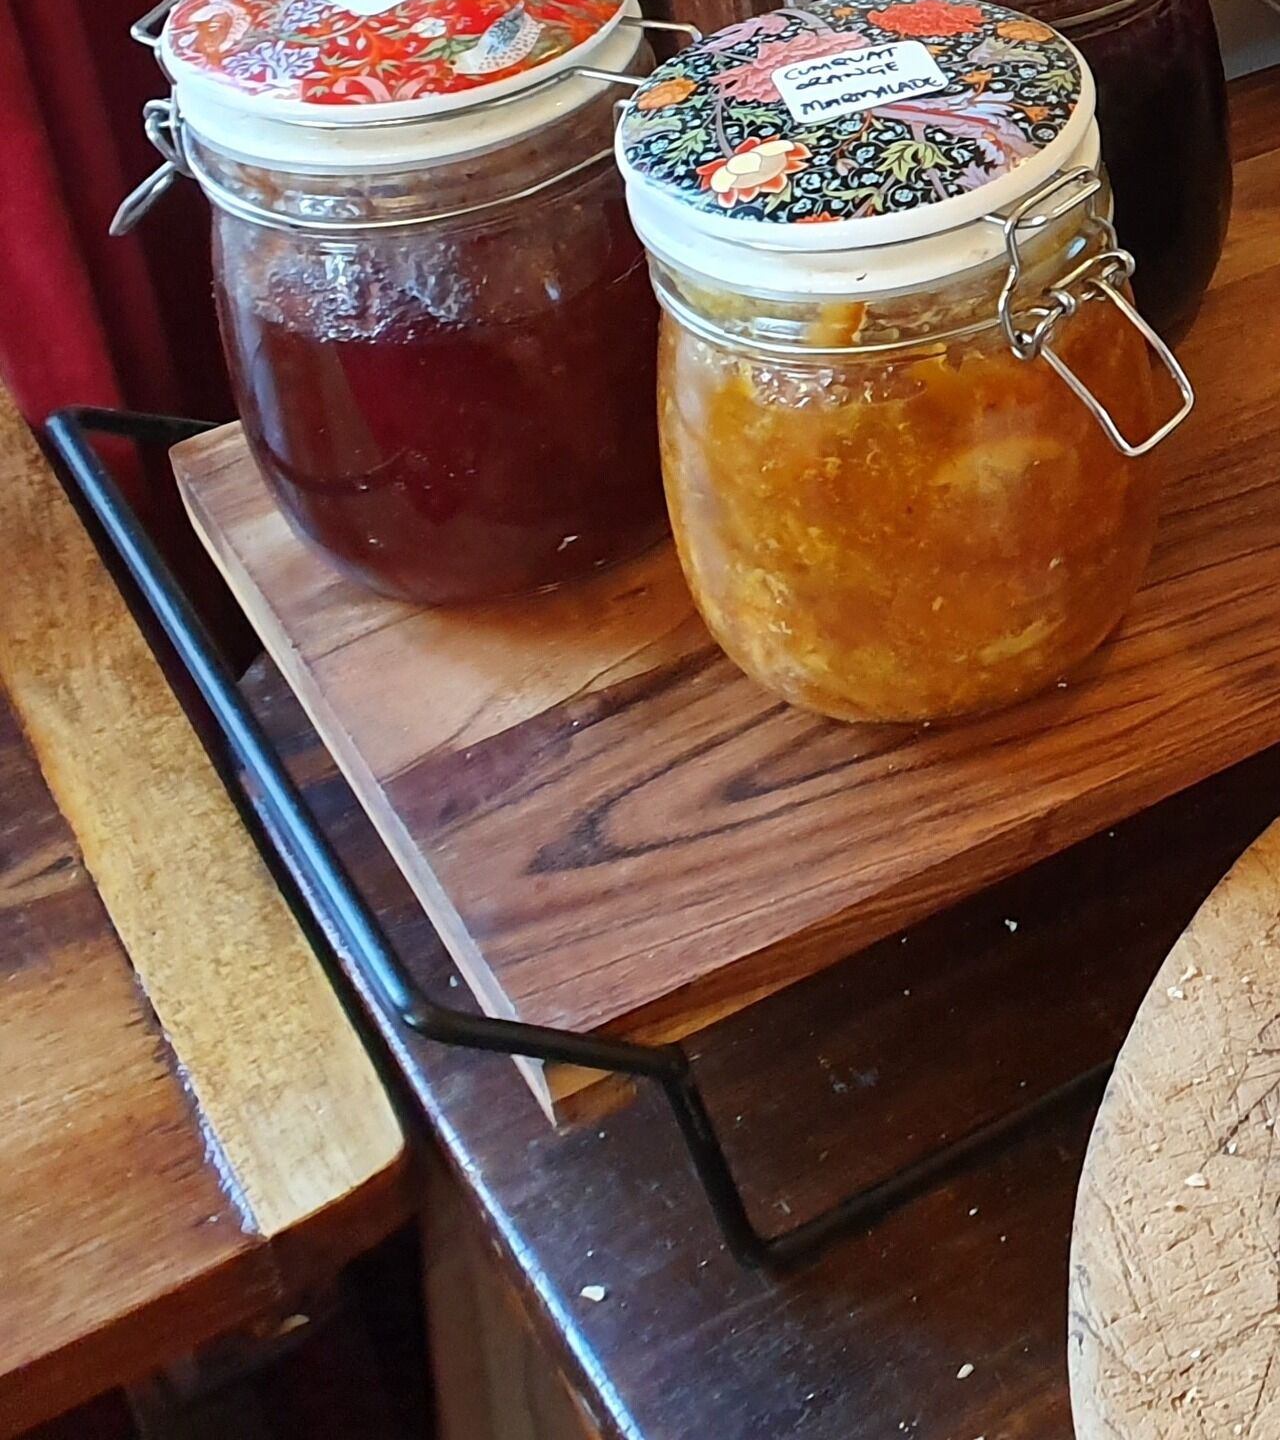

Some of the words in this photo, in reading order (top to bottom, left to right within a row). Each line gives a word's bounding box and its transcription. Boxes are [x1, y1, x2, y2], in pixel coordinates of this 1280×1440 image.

[783, 46, 898, 80] CUMQUAT
[795, 61, 899, 90] ORANGE
[800, 77, 943, 115] MARMALADE
